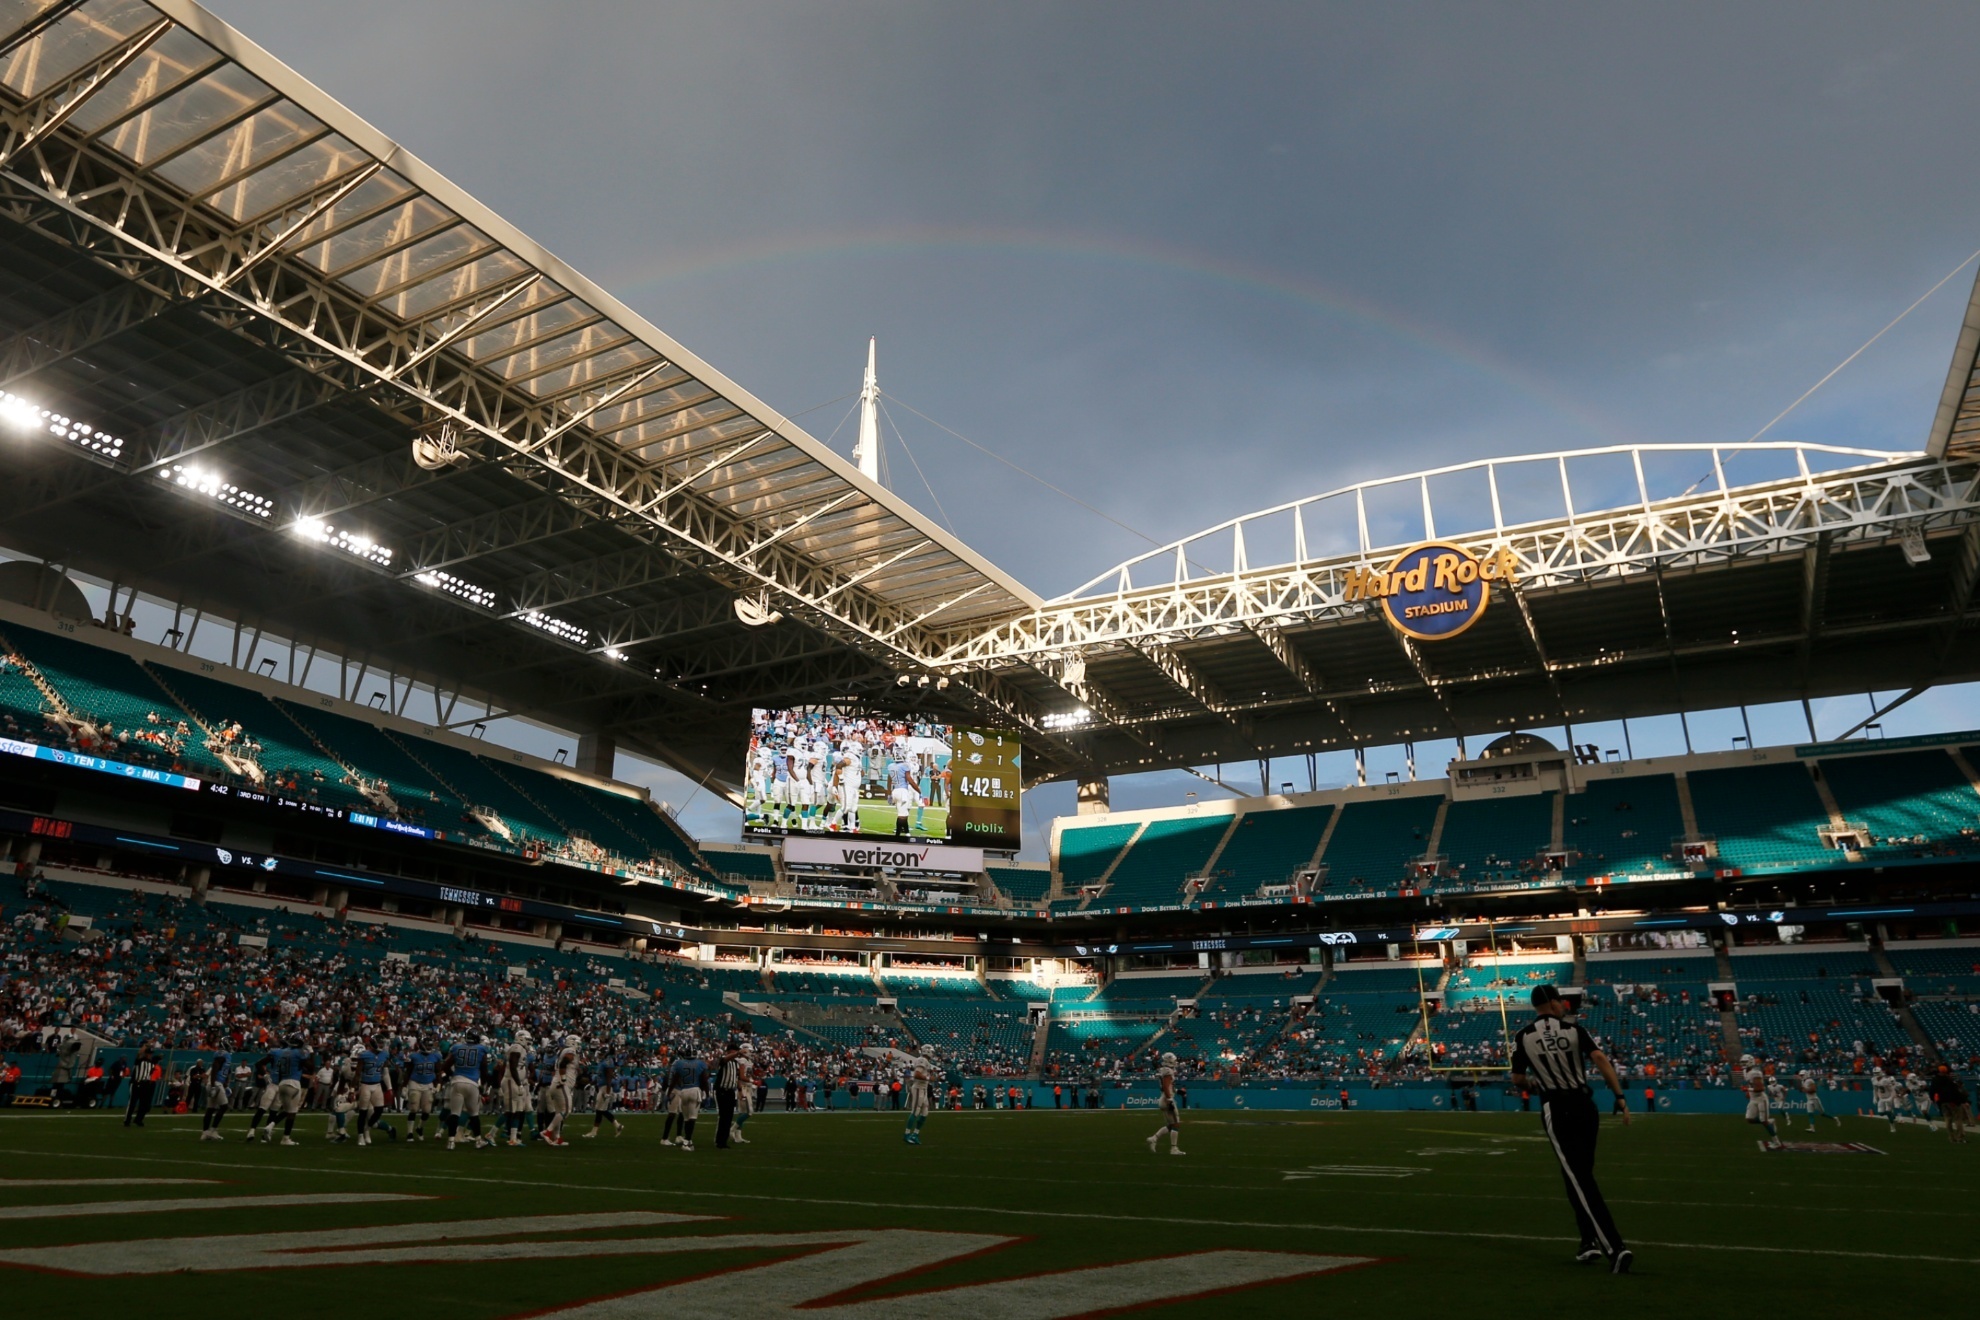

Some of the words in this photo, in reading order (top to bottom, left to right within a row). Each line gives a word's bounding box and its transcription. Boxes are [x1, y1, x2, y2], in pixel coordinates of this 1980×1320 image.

[1344, 556, 1429, 602] Hard
[1433, 545, 1521, 593] Rock
[1405, 599, 1468, 619] STADIUM
[58, 621, 75, 633] 318
[200, 662, 215, 673] 319
[320, 697, 334, 708] 320
[423, 727, 434, 736] 321
[997, 735, 1003, 747] 3
[74, 754, 95, 767] TEN
[99, 760, 106, 769] 3
[997, 754, 1003, 766] 7
[142, 769, 160, 780] MIA
[165, 774, 172, 782] 7
[960, 776, 990, 797] 4:42
[210, 783, 229, 795] 4:42
[252, 793, 265, 801] QTR
[278, 798, 284, 806] 3
[301, 802, 307, 811] 2
[992, 789, 1003, 798] 3RD
[337, 810, 343, 818] 6
[965, 821, 1004, 834] Publix
[469, 838, 483, 848] DON
[484, 841, 501, 853] SHULA
[842, 846, 919, 867] verizon
[1629, 874, 1653, 882] MARK
[1654, 873, 1681, 881] DUPER
[1684, 871, 1696, 879] 85
[440, 886, 480, 905] TENNESSEE
[1345, 892, 1375, 900] CLAYTON
[794, 899, 831, 908] STEPHENSON
[971, 908, 1000, 916] RICHMOND
[1192, 939, 1226, 950] TENNESSEE
[1536, 1037, 1570, 1052] 120
[457, 1048, 479, 1068] 90
[683, 1067, 695, 1085] 21
[1127, 1096, 1161, 1107] Dolphin
[1310, 1098, 1358, 1108] Dolphns
